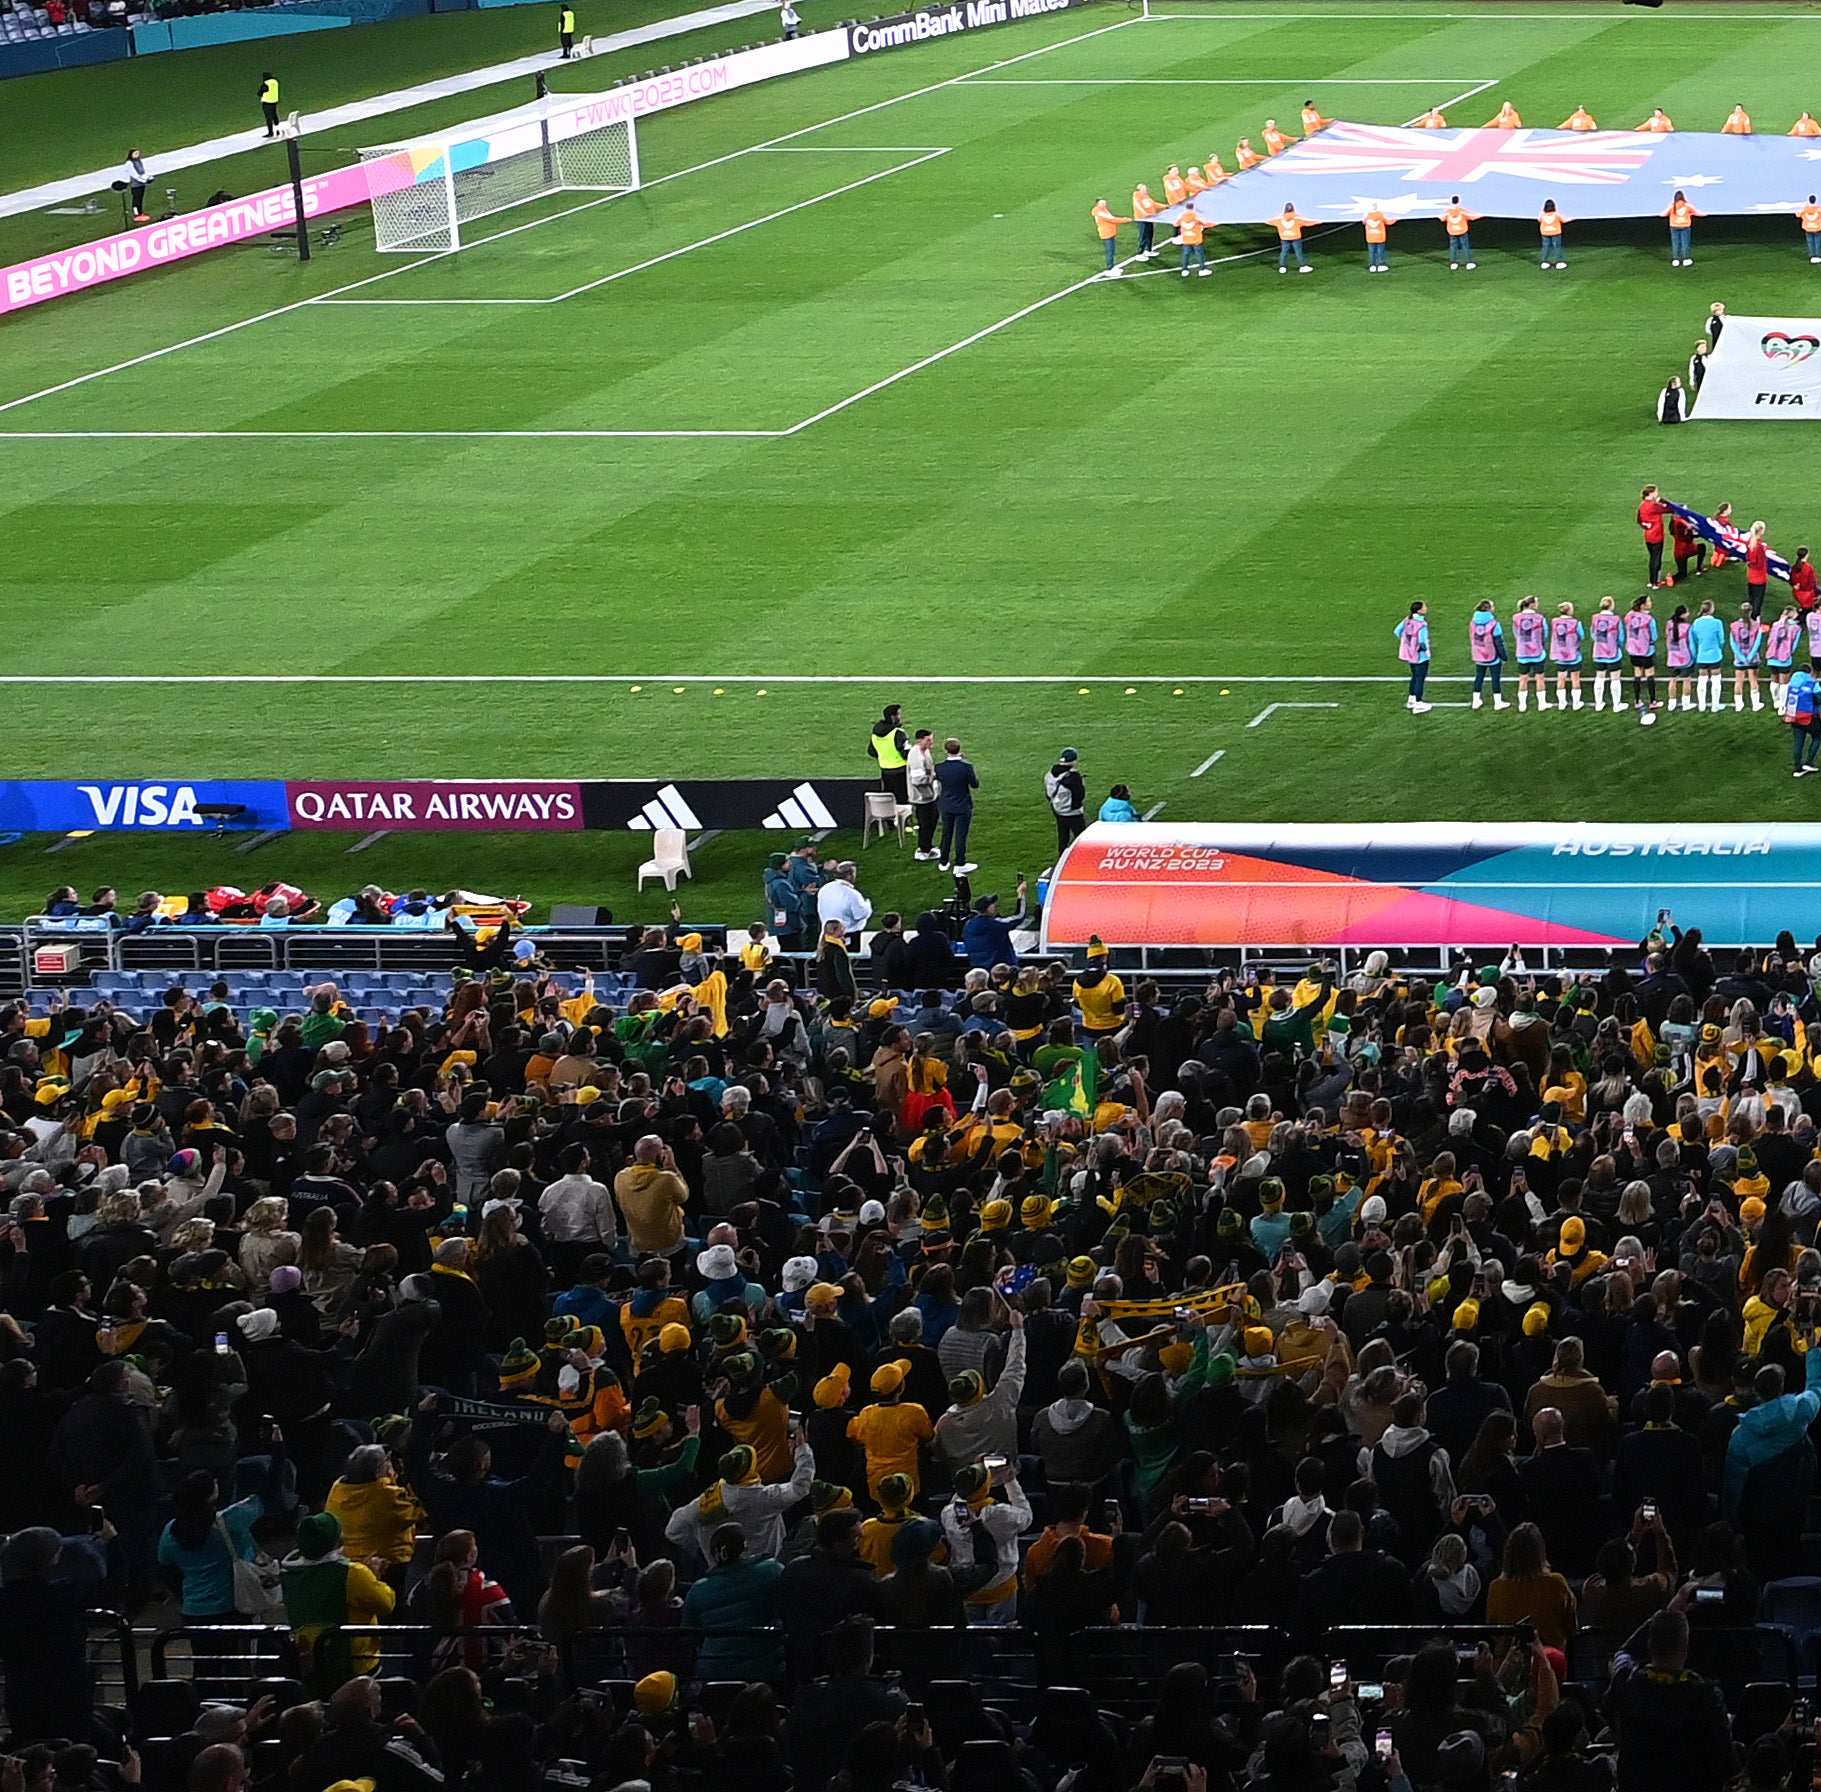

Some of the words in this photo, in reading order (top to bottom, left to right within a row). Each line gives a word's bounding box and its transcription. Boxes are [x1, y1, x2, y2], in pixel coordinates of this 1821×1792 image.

[852, 4, 971, 55] CommBank
[6, 238, 142, 306] BEYOND
[1754, 392, 1805, 406] FIFA
[76, 785, 203, 826] VISA
[294, 791, 418, 823] QATAR
[424, 791, 577, 821] AIRWAYS
[1106, 847, 1175, 859] WORLD
[1179, 848, 1220, 859] CUP
[1551, 838, 1772, 857] AUSTRALIA
